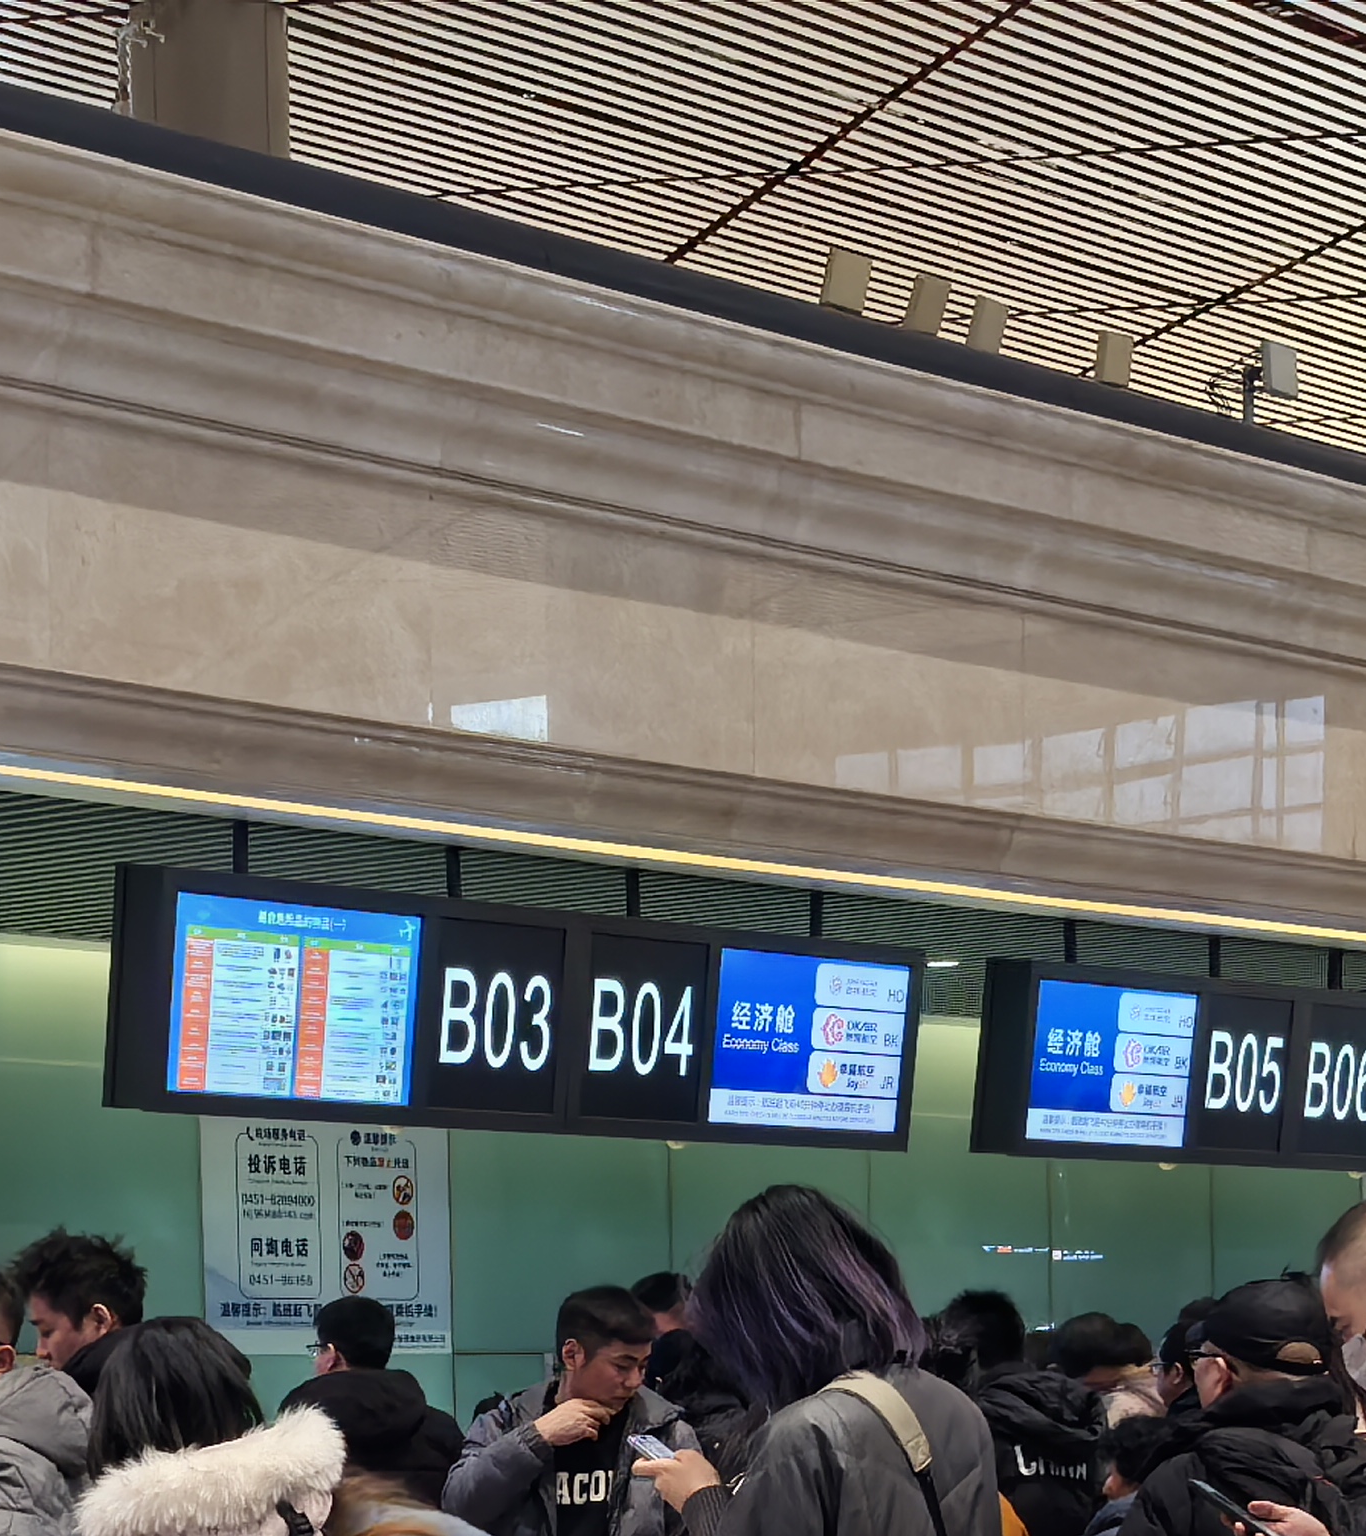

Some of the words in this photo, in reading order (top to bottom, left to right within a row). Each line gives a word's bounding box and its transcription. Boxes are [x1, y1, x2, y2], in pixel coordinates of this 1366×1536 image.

[439, 967, 551, 1071] B03
[588, 978, 693, 1076] B04
[731, 1000, 795, 1034] 经济舱
[722, 1034, 769, 1055] Economy
[771, 1038, 800, 1053] Class
[1047, 1028, 1102, 1058] 经济舱
[1039, 1057, 1078, 1077] Economy
[1080, 1061, 1104, 1075] Class
[1204, 1030, 1284, 1114] B05
[247, 1154, 308, 1177] 投诉电话
[250, 1237, 309, 1258] 问询电话
